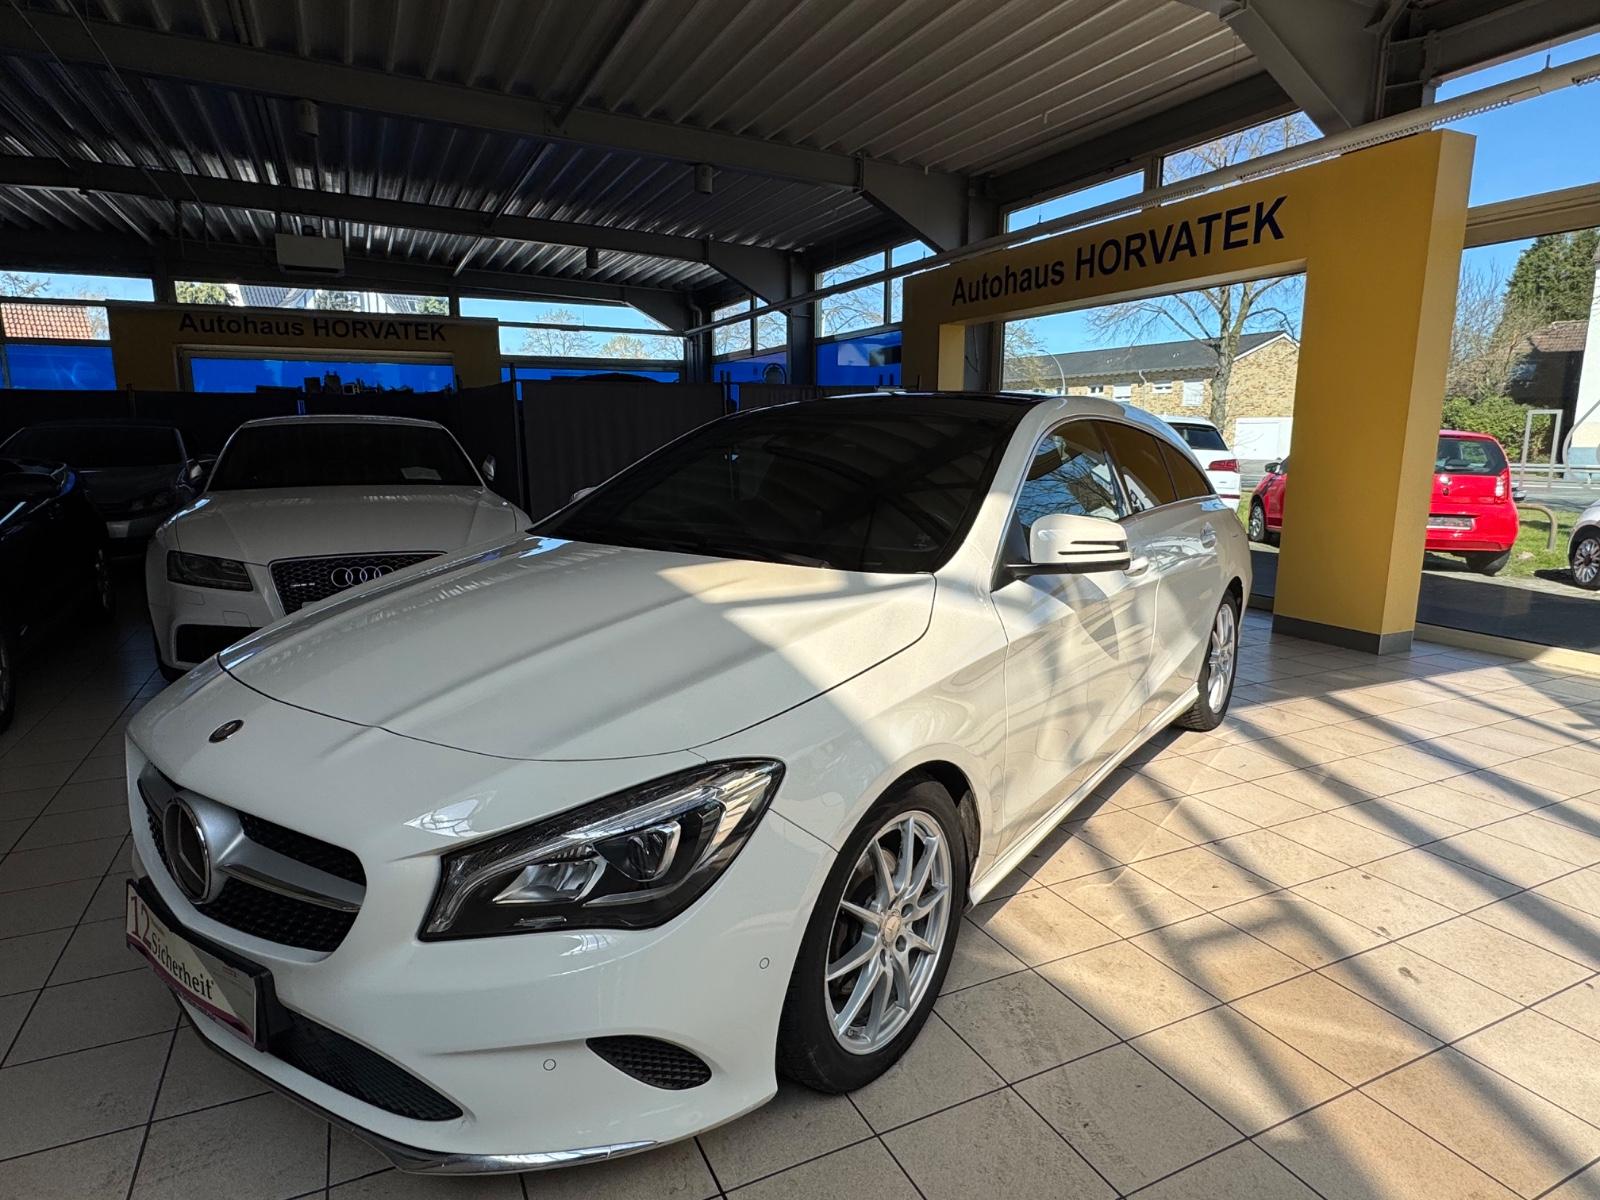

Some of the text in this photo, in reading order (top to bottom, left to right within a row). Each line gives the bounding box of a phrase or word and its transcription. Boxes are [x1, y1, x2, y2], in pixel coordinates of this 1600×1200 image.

[951, 196, 1287, 306] Autohaus HORVATEK
[178, 312, 447, 342] Autohaus HORVATEK
[131, 896, 152, 951] 12
